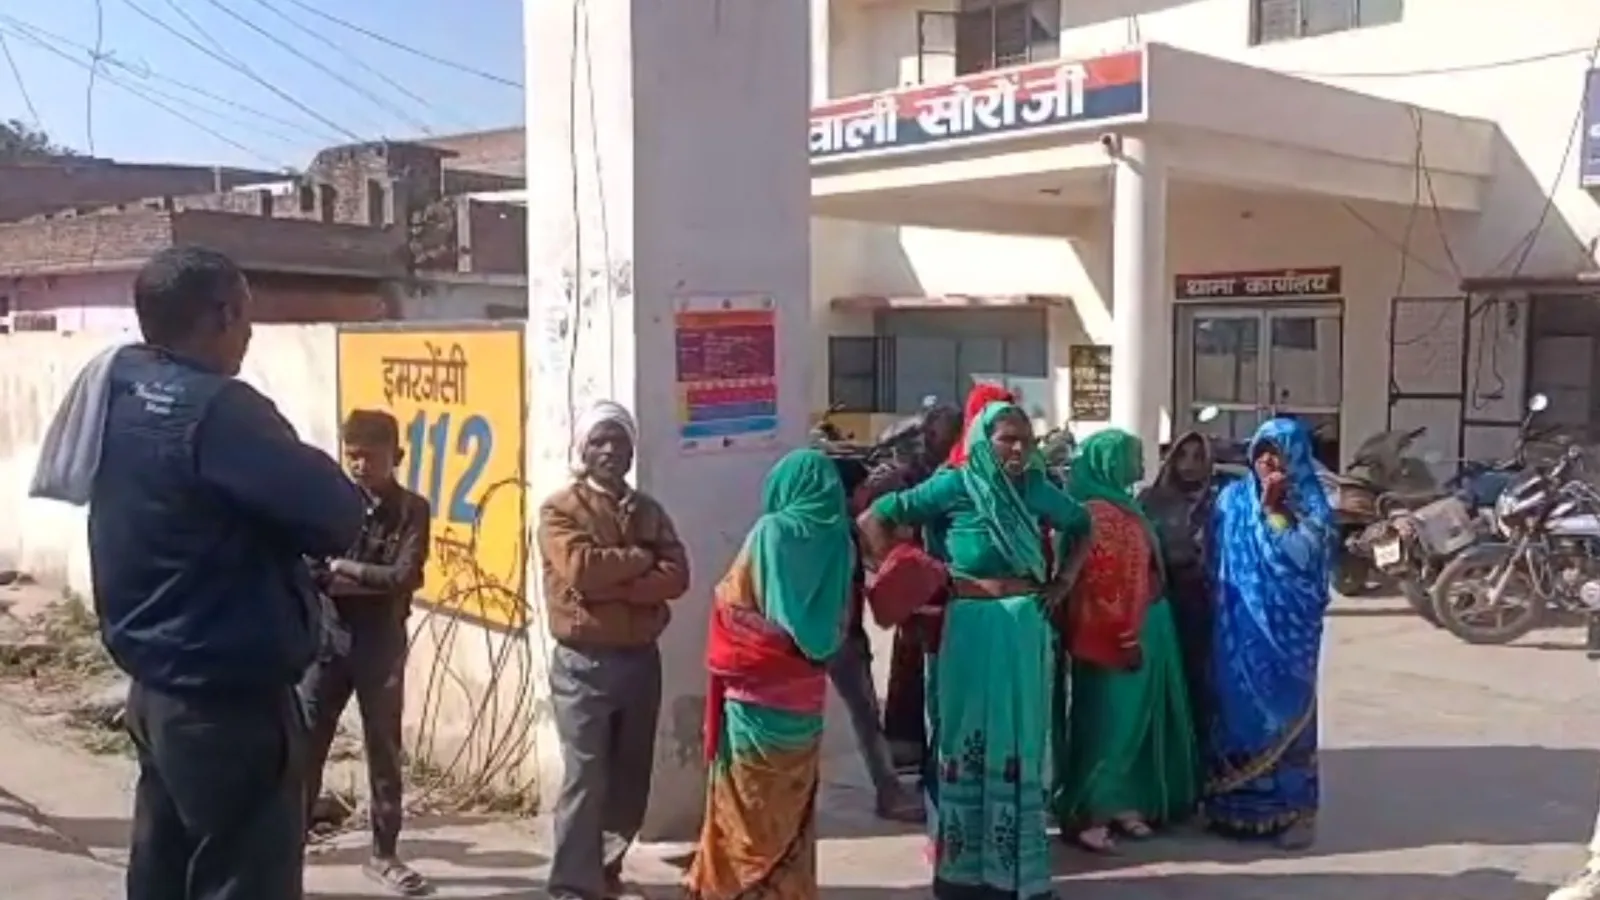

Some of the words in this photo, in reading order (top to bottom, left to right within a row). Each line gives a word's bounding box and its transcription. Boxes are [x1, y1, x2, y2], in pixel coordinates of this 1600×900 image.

[1186, 278, 1237, 296] थाना
[381, 340, 468, 406] इमरजेंसी
[407, 409, 493, 524] 112
